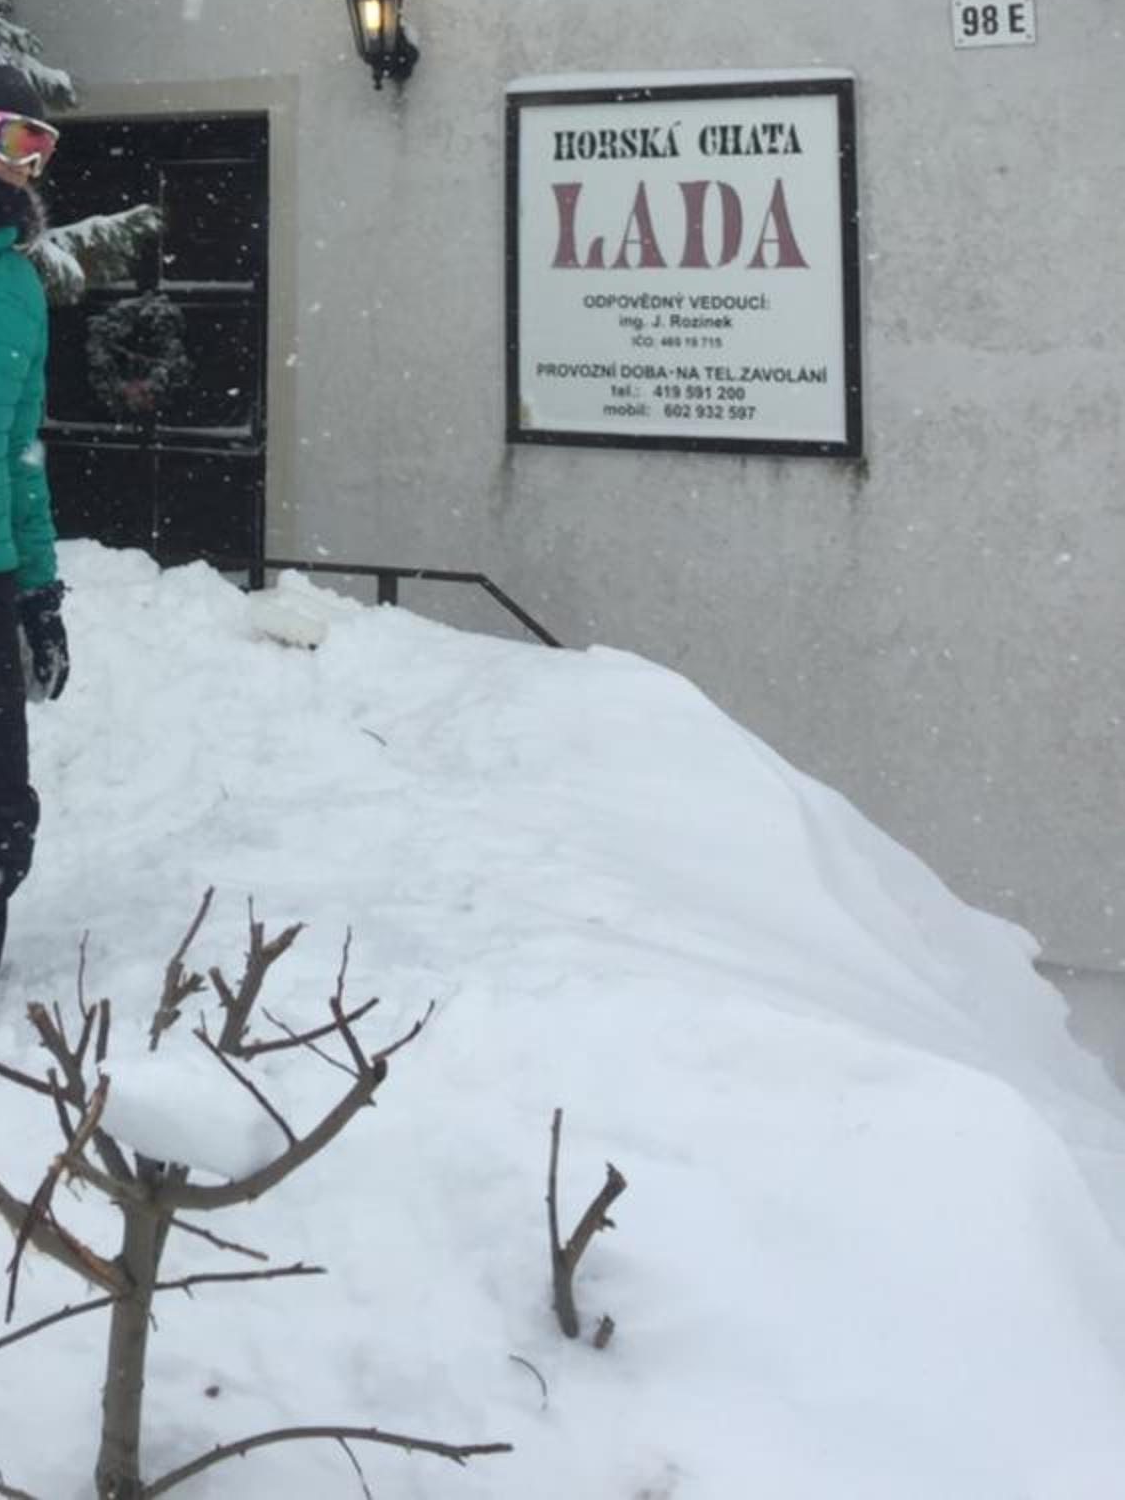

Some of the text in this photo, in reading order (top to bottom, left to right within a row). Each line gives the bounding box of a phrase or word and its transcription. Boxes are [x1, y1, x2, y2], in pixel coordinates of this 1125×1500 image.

[962, 3, 1026, 36] 98 E
[553, 121, 803, 160] HORSKÁ CHATA
[551, 177, 810, 269] LADA
[583, 292, 684, 310] ODPOVĚDNÝ
[618, 314, 733, 331] ing. J. Rozinek
[536, 360, 617, 378] PROVOZNÍ
[717, 385, 746, 401] 200
[664, 403, 691, 418] 602
[695, 404, 723, 419] 932
